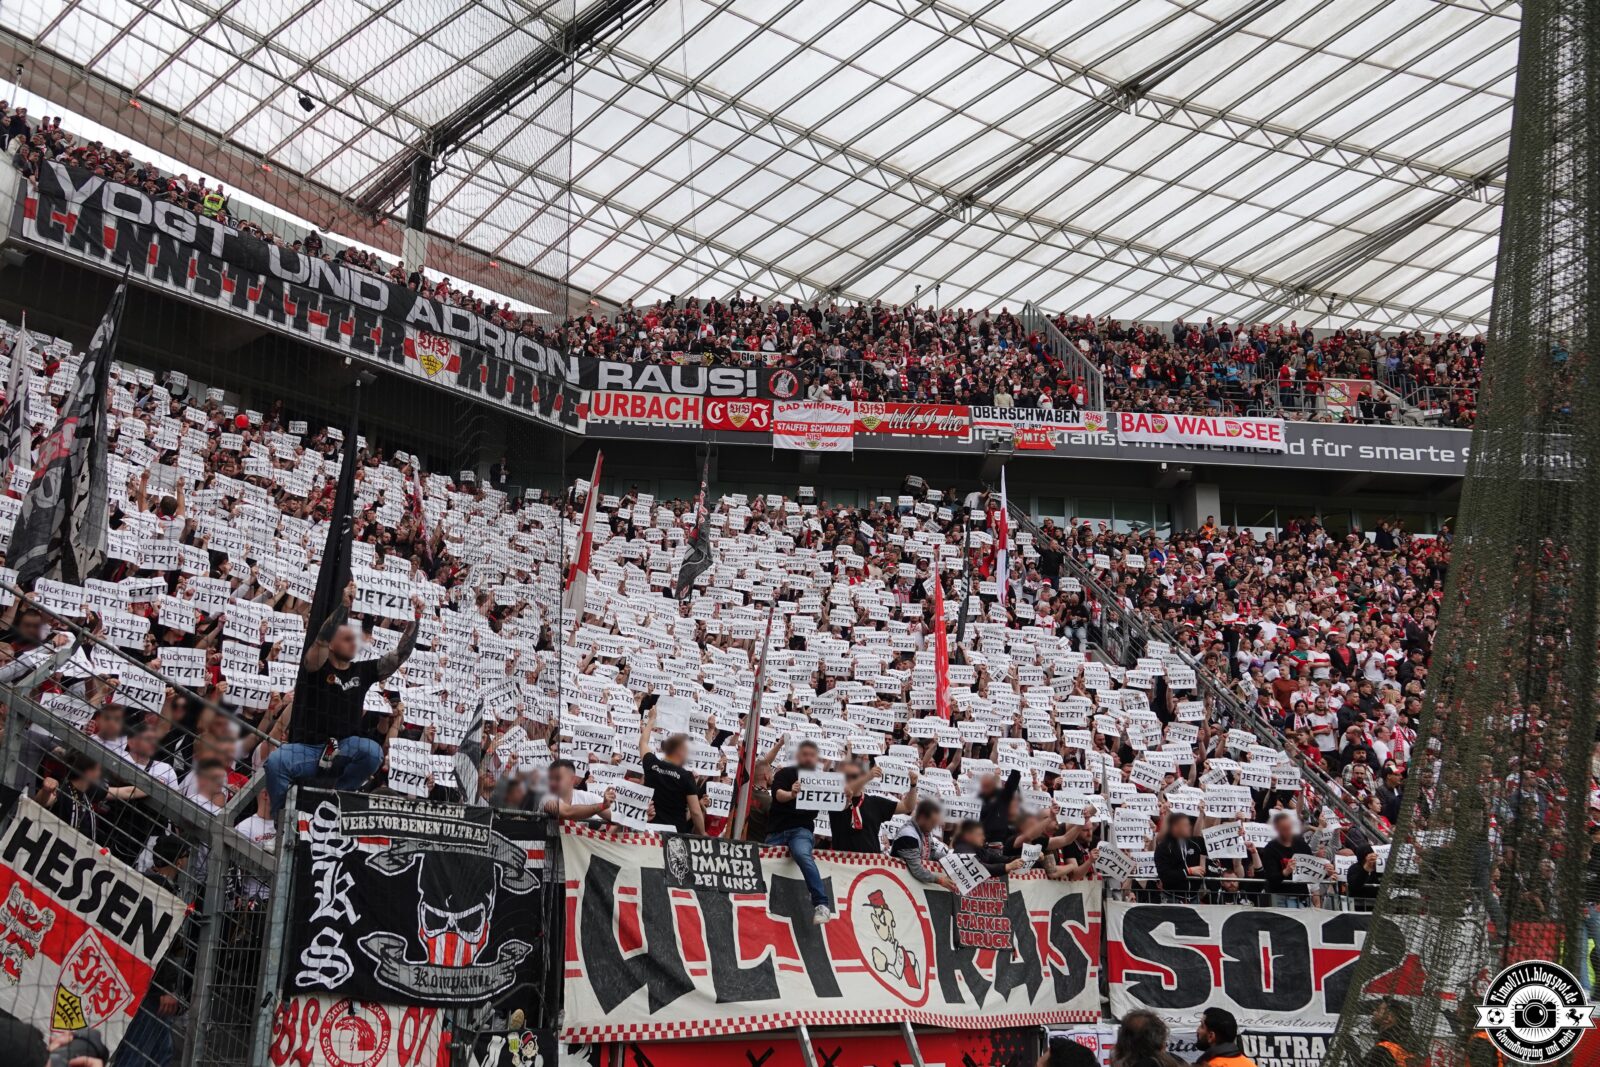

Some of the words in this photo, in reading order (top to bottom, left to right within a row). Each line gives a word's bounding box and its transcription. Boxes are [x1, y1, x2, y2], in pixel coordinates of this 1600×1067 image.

[268, 244, 390, 312] UND
[406, 296, 580, 385] ADRION
[598, 361, 757, 398] RAUS!
[593, 392, 700, 421] URBACH
[778, 403, 800, 413] BAD
[804, 401, 851, 416] WIMPFEN
[973, 406, 1080, 423] OBERSCHWABEN
[777, 422, 808, 432] STAUFER
[810, 424, 851, 433] SCHWABEN
[1121, 413, 1168, 434] BAD
[1174, 416, 1281, 442] WALDSEE
[1023, 433, 1046, 442] MTS
[1312, 438, 1352, 457] für
[1359, 445, 1456, 463] smarte
[356, 574, 411, 590] RÜCKTRITT
[85, 594, 128, 610] JETZT!
[356, 589, 412, 610] JETZT!
[160, 610, 195, 627] JETZT!
[160, 653, 205, 663] RÜCKTRITT
[160, 666, 205, 678] JETZT!
[222, 659, 258, 675] JETZT!
[115, 684, 163, 704] JETZT!
[225, 685, 271, 702] JETZT!
[576, 730, 614, 741] RÜCKTRITT
[575, 741, 613, 755] JETZT!
[391, 756, 430, 770] RÜCKTRITT
[389, 769, 426, 788] JETZT!
[801, 778, 841, 787] RÜCKTRITT
[880, 773, 909, 787] JETZT!
[1132, 771, 1161, 784] JETZT!
[1242, 774, 1271, 783] JETZT!
[615, 786, 651, 803] RÜCKTRITT
[798, 789, 845, 803] JETZT!
[612, 801, 648, 822] JETZT!
[342, 816, 442, 835] VERSTORBENEN
[443, 821, 489, 843] ULTRAS
[1205, 826, 1240, 840] RÜCKTRITT
[689, 839, 714, 855] DU
[720, 842, 752, 859] BIST
[692, 855, 756, 877] IMMER
[2, 816, 173, 961] HESSEN
[694, 873, 718, 887] BEI
[723, 876, 758, 890] UNS!
[961, 897, 1004, 915] KEHRT
